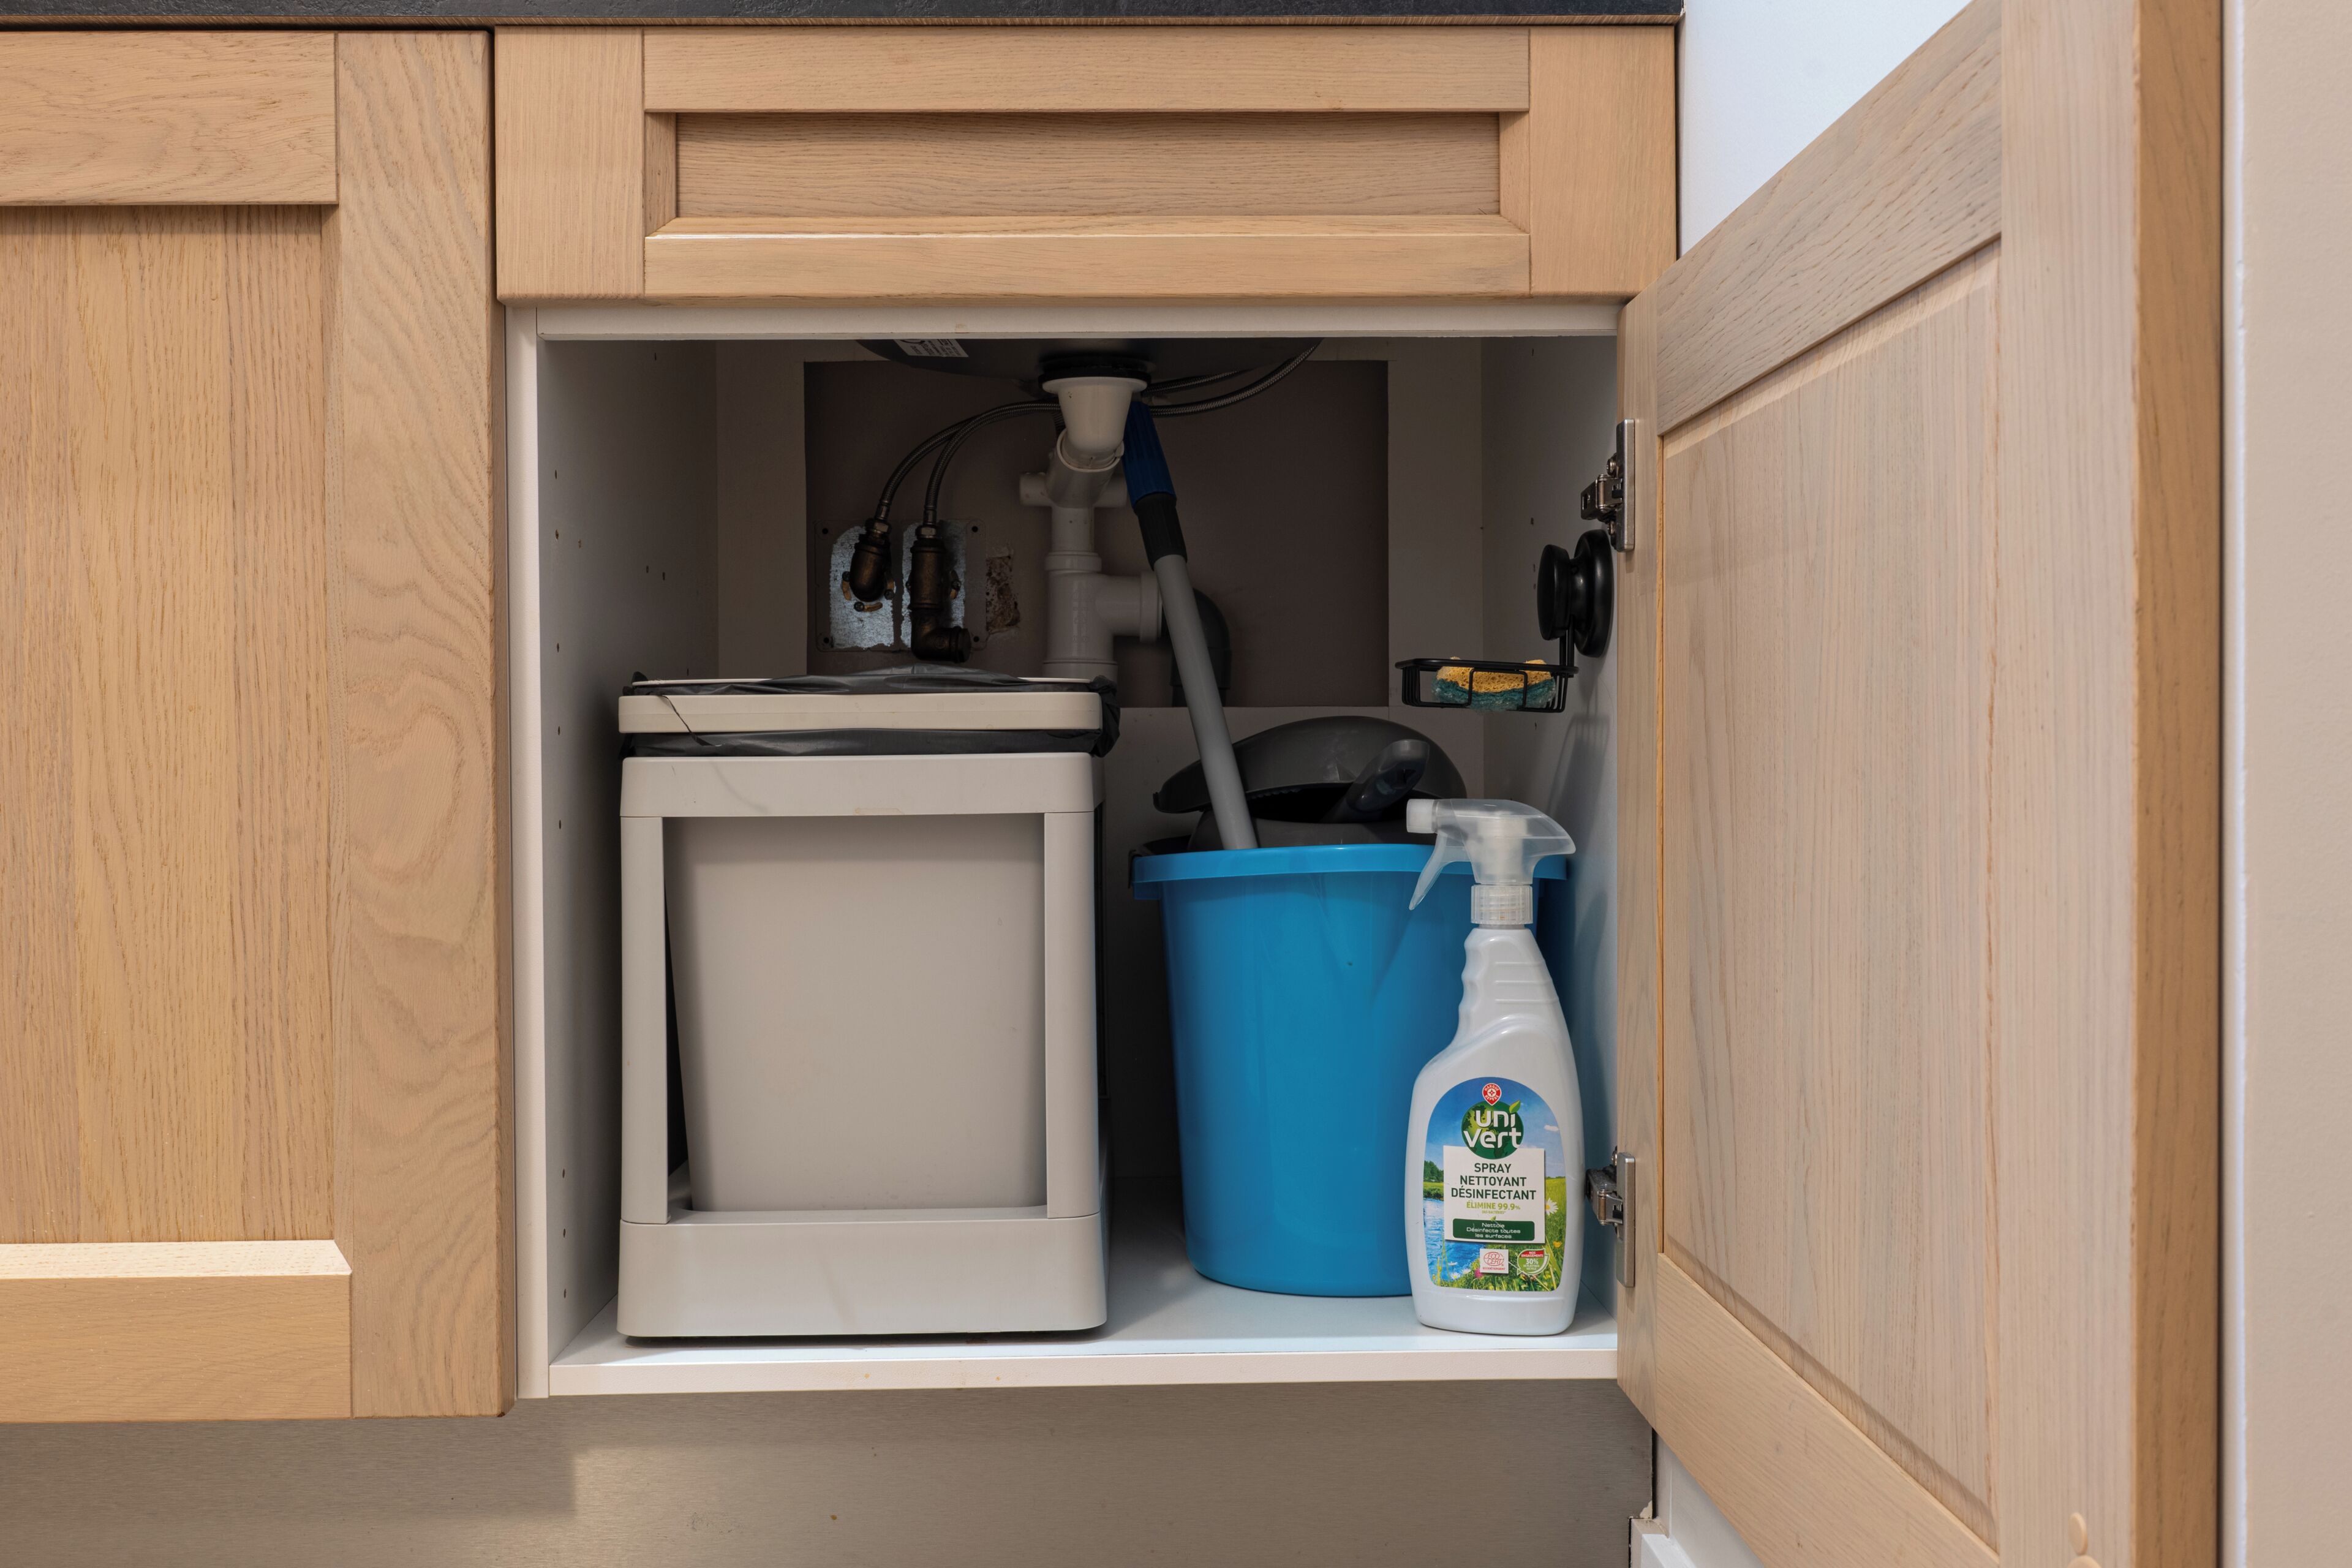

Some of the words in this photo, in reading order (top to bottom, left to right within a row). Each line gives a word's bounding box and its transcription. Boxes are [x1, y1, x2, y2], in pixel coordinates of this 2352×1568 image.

[1476, 1110, 1515, 1128] uni
[1474, 1163, 1512, 1173] SPRAY
[1460, 1175, 1527, 1186] NETTOYANT
[1451, 1185, 1537, 1200] DÉSINFECTANT
[1466, 1200, 1496, 1209] ÉLIMINE
